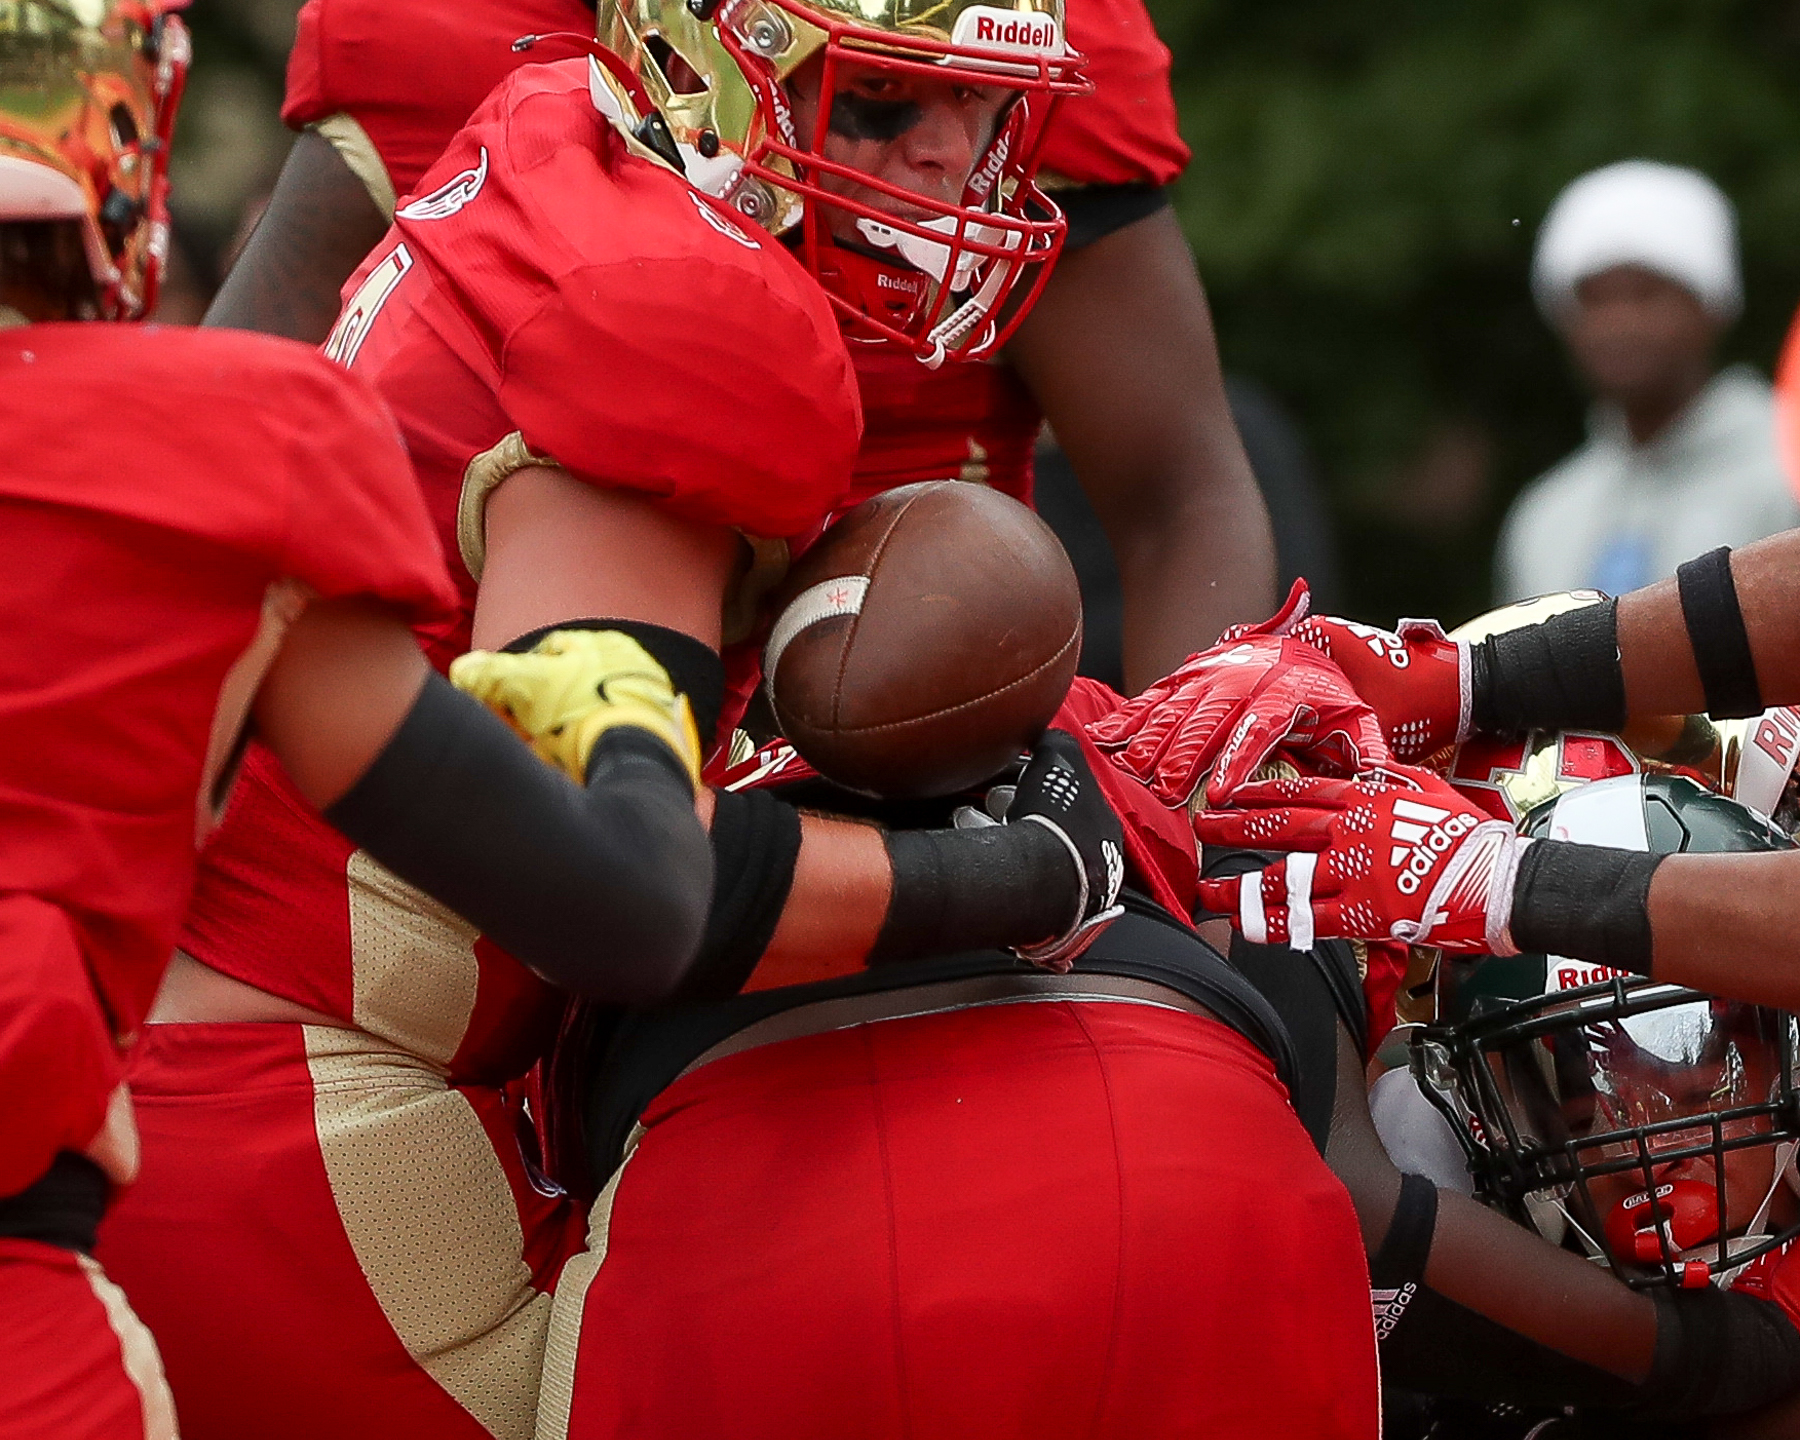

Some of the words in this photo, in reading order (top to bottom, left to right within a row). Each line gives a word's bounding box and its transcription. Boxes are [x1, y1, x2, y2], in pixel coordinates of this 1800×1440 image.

[977, 16, 1054, 47] Riddell
[1397, 813, 1478, 895] adidas
[1377, 1282, 1417, 1340] adidas
